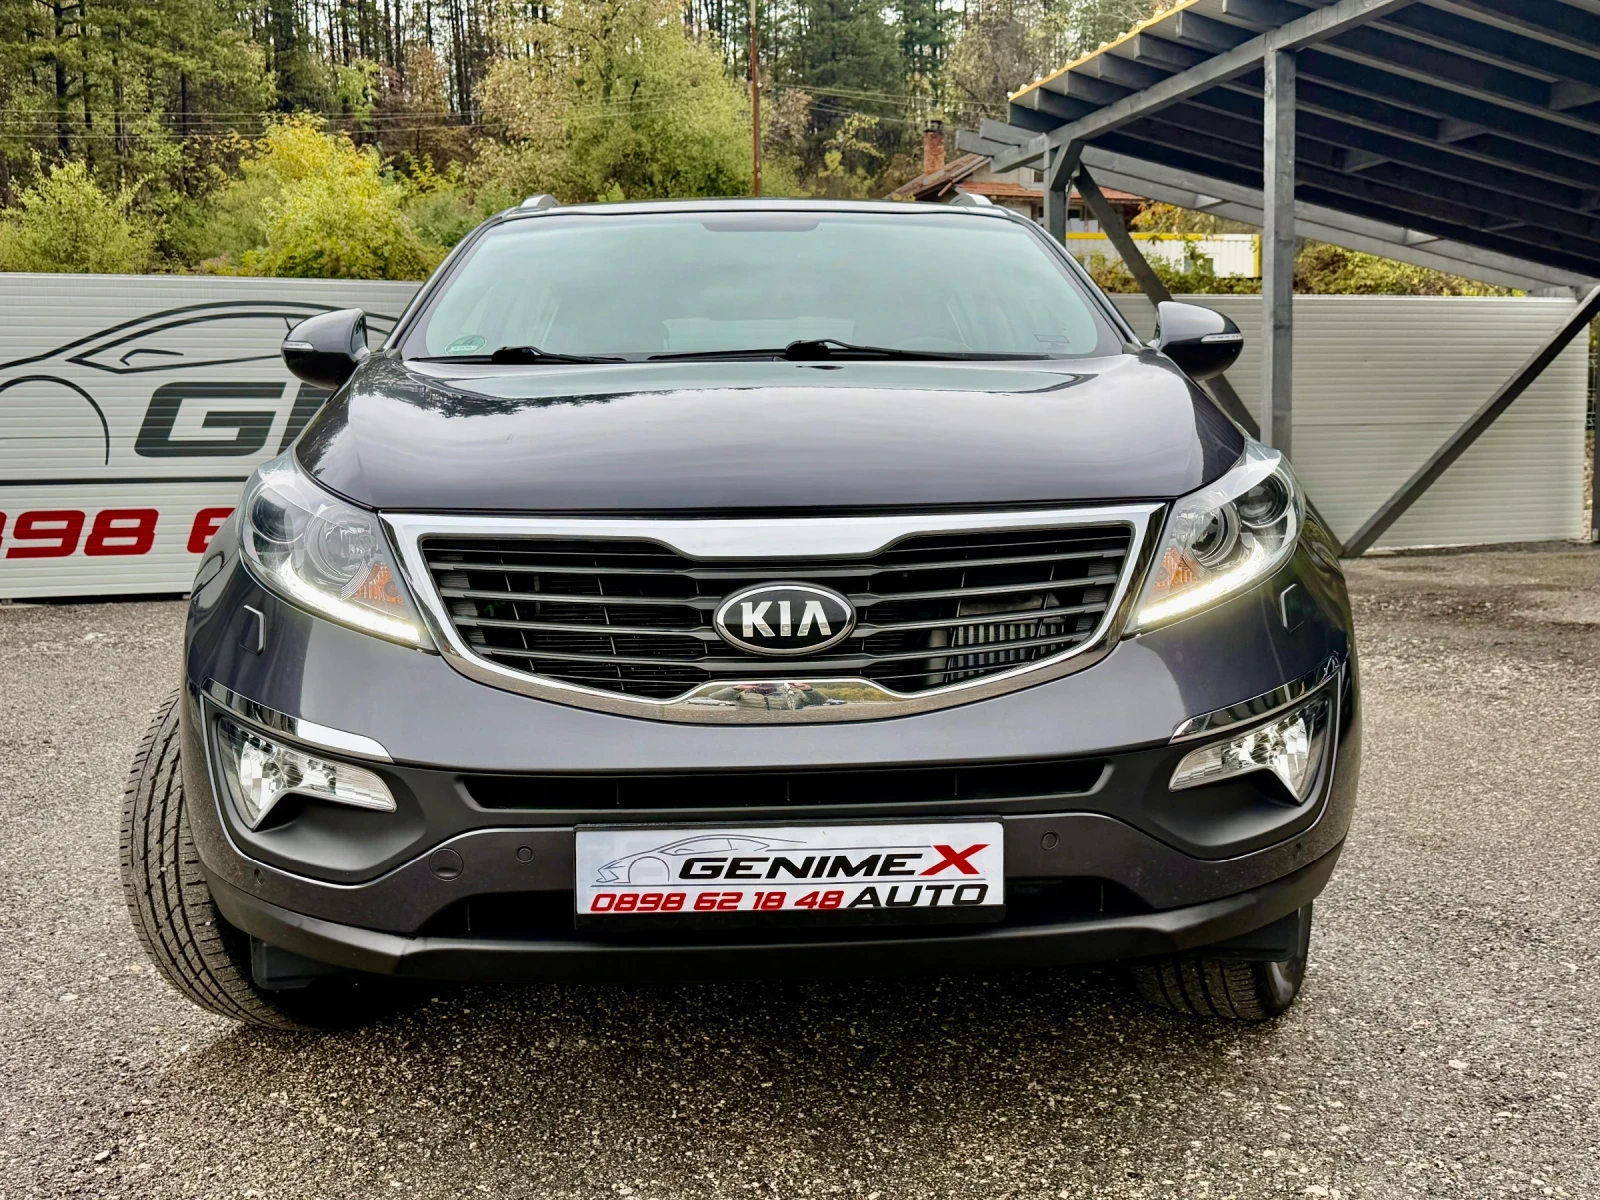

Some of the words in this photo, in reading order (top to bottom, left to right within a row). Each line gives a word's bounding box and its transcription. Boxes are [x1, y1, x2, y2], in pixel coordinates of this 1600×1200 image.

[0, 508, 160, 559] 98
[740, 600, 832, 638] KIA
[678, 843, 991, 880] GENIMEX
[590, 893, 687, 912] 0898
[693, 892, 744, 911] 62
[752, 891, 787, 911] 18
[794, 890, 844, 909] 48
[846, 883, 989, 909] AUTO
